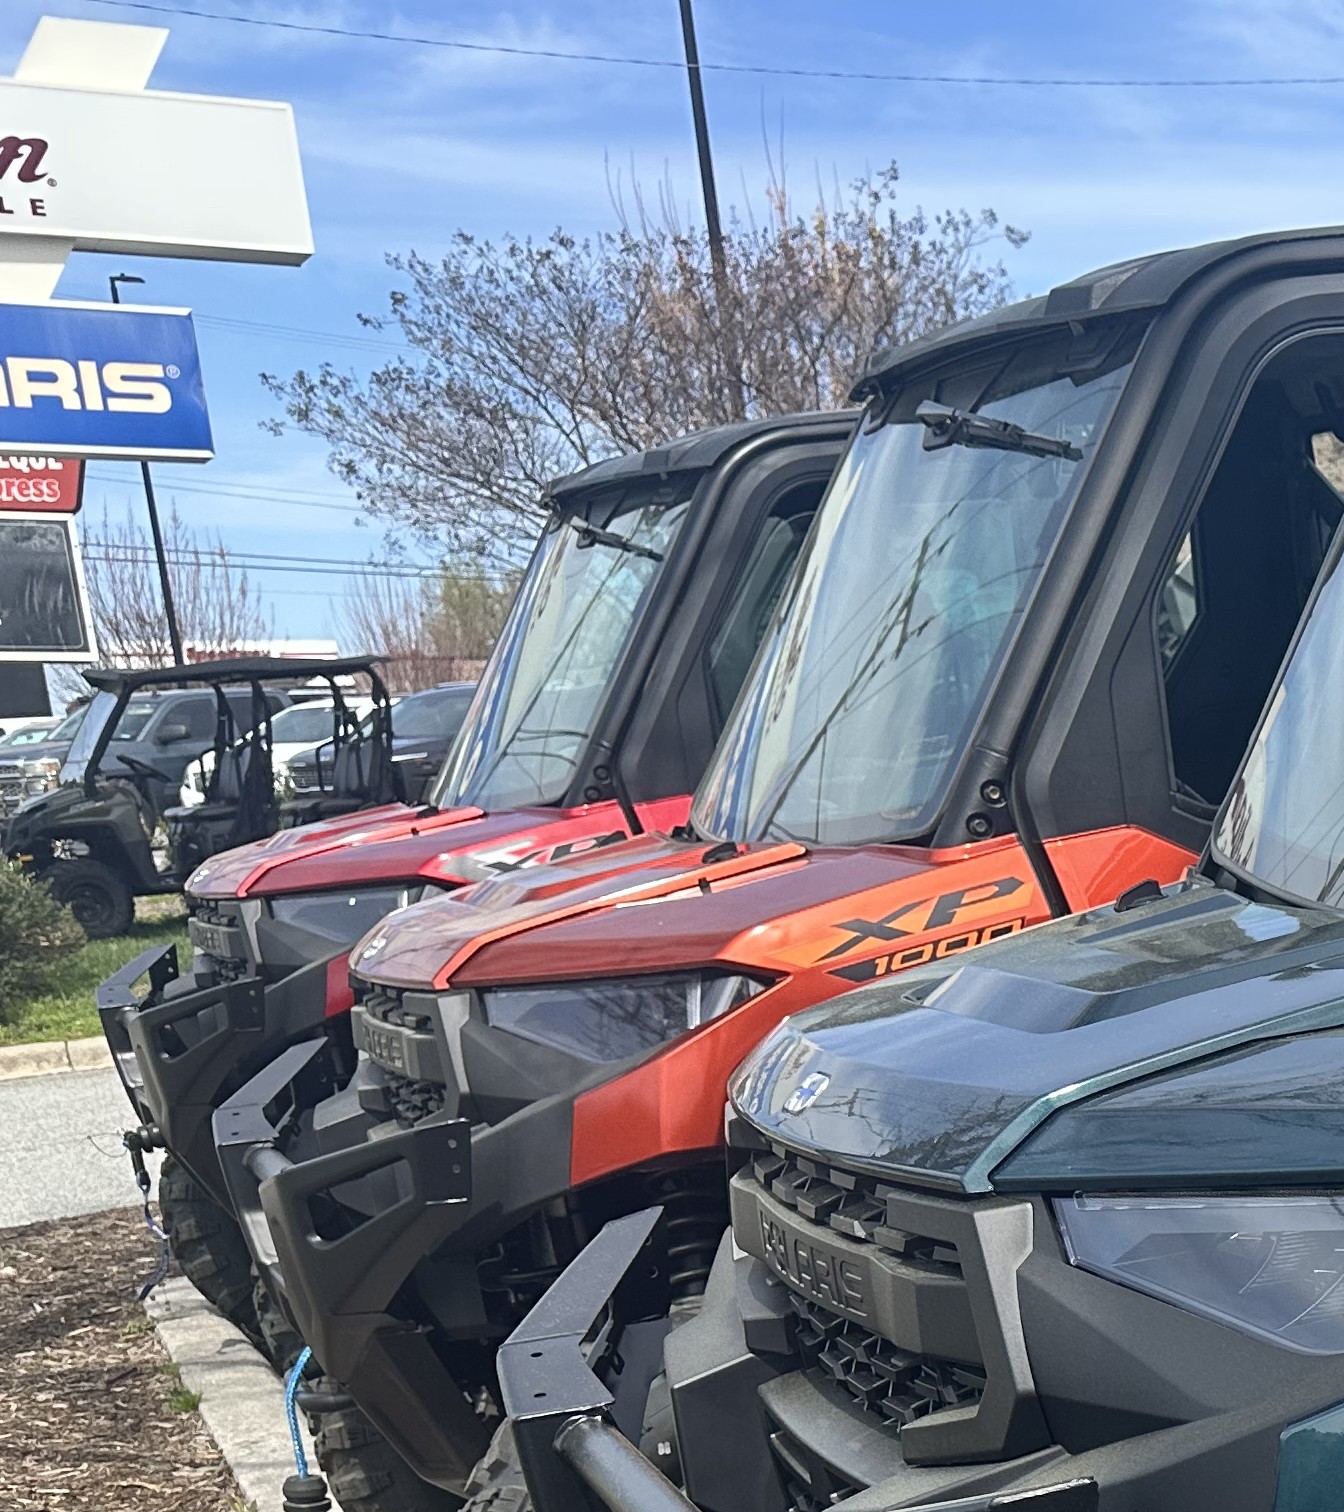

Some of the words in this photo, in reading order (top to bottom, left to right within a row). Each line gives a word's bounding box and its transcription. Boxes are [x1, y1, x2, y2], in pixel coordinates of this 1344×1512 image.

[0, 356, 173, 414] RIS
[812, 876, 1025, 964] XP
[874, 918, 1024, 976] 1000
